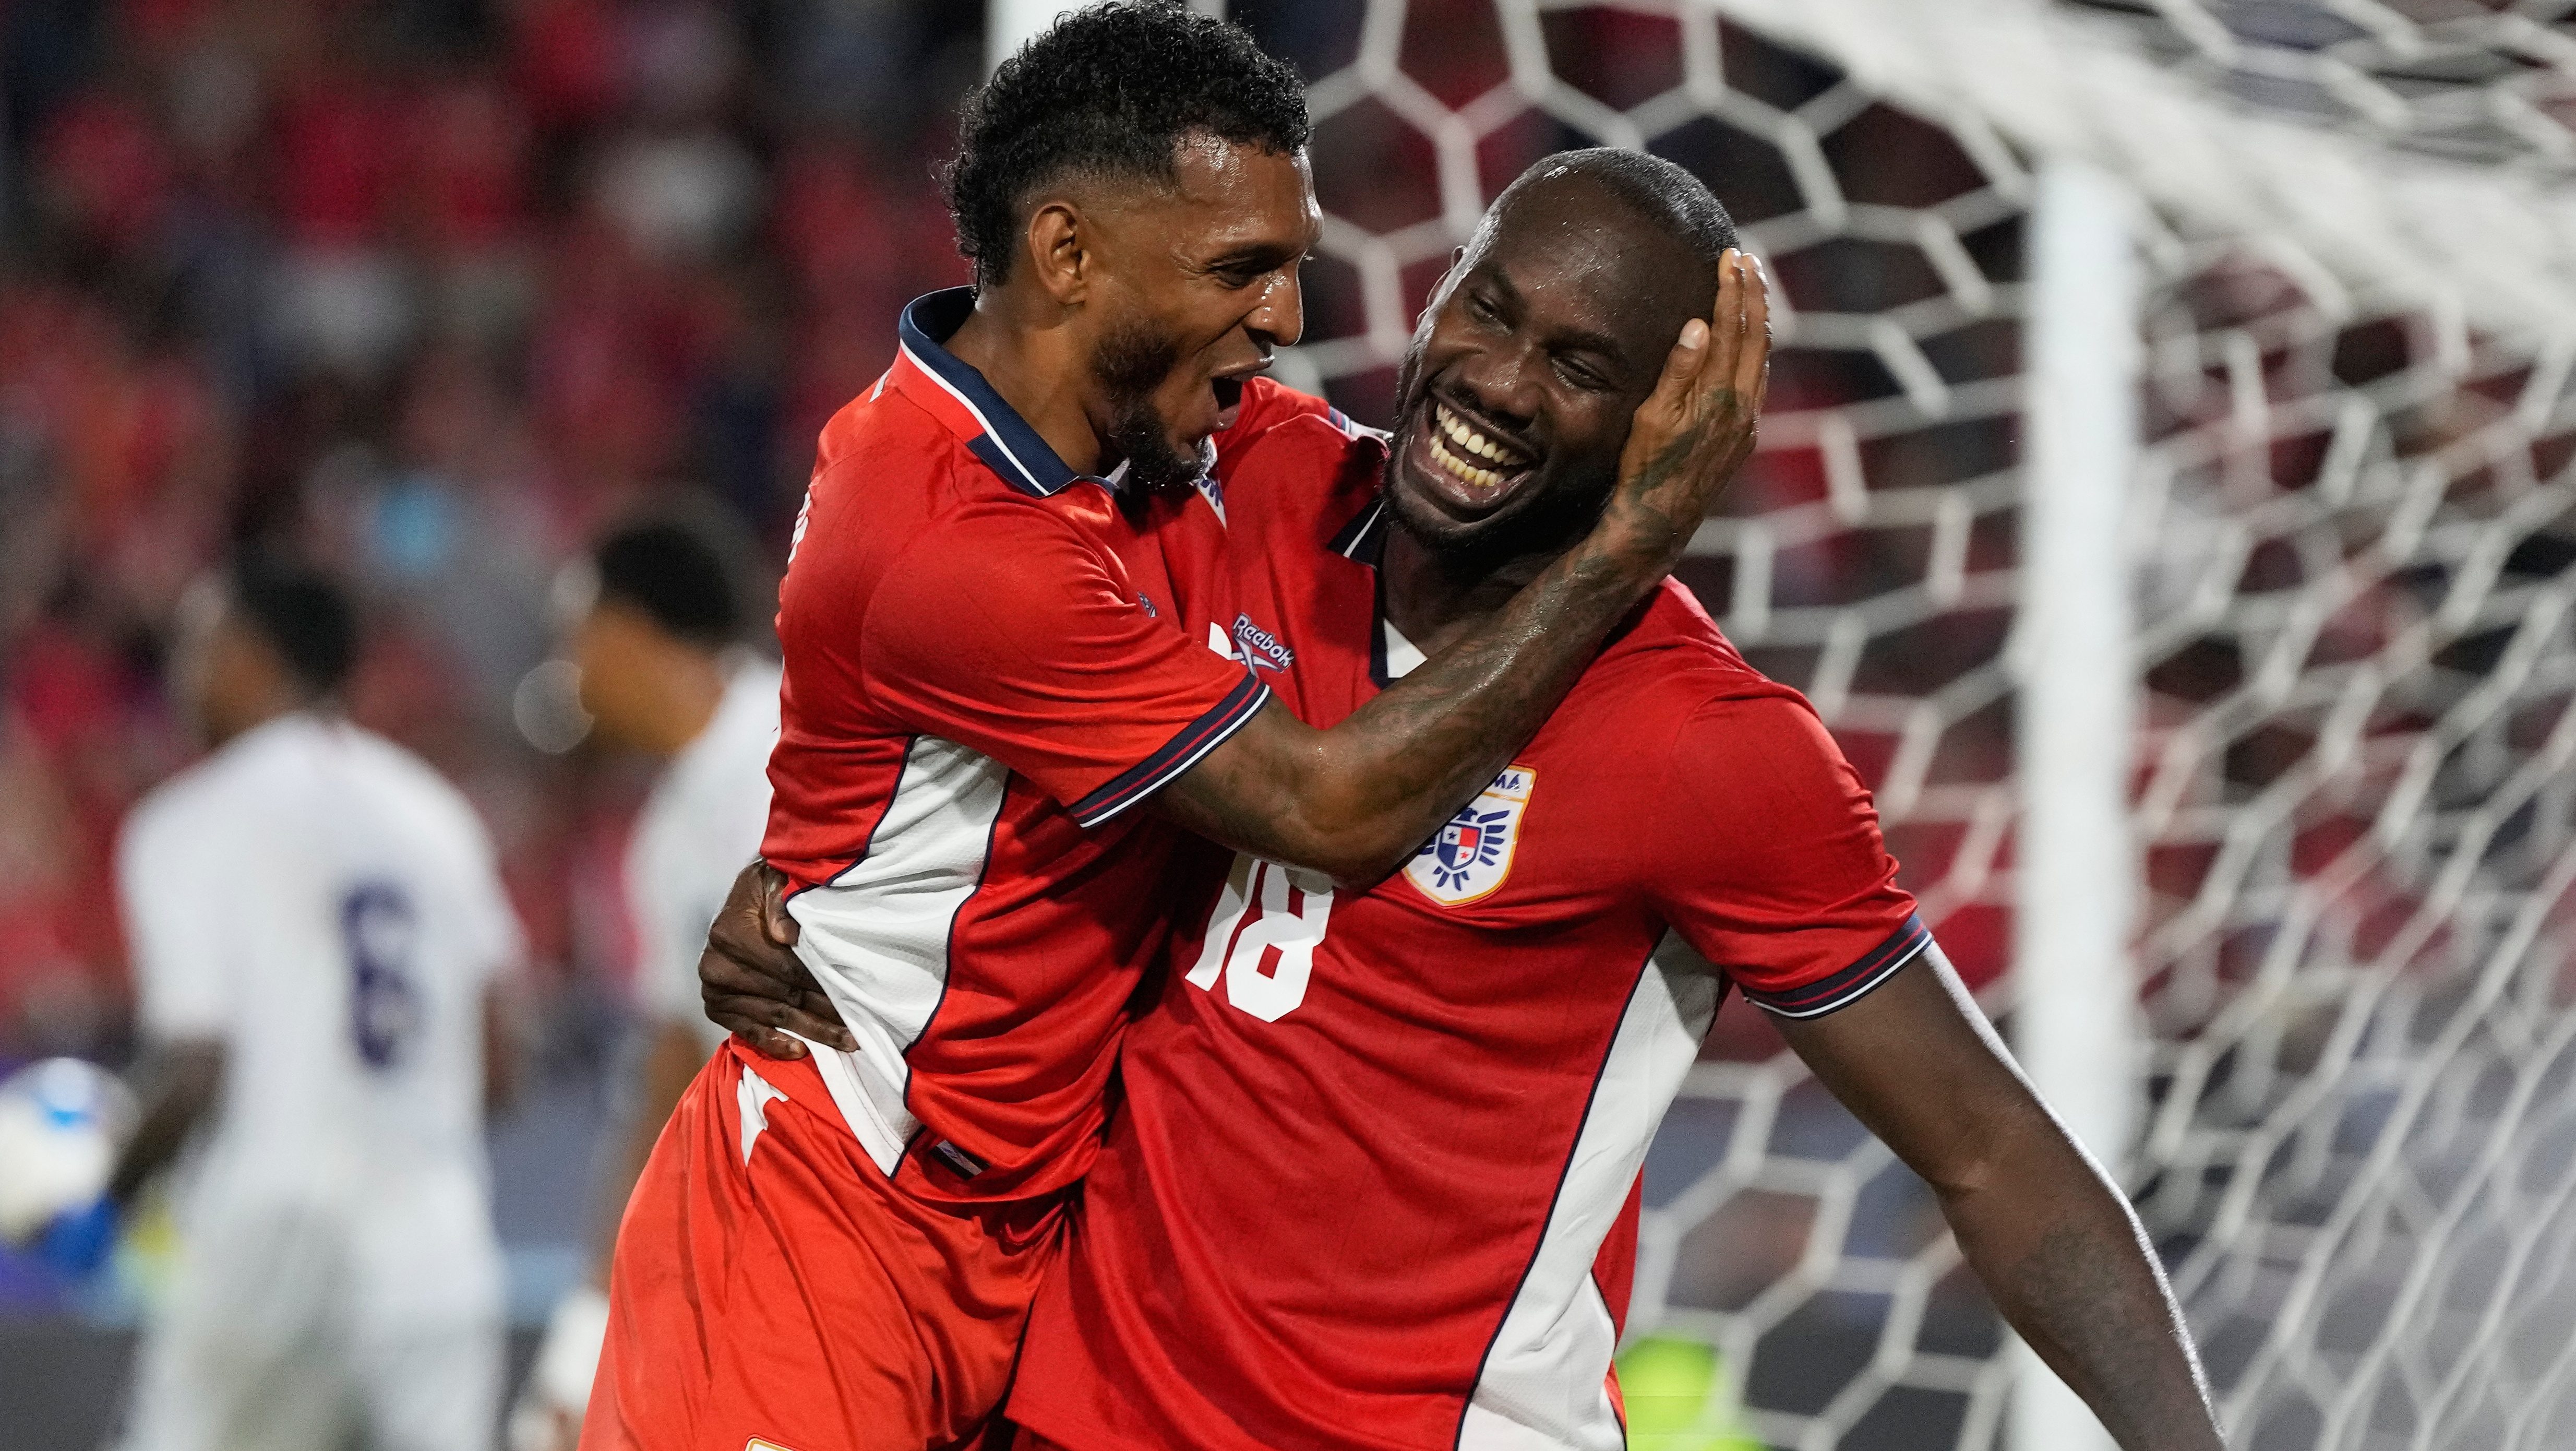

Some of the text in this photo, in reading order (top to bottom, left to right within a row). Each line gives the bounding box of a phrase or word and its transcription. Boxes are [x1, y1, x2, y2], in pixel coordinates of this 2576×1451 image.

[1233, 613, 1295, 668] Reebok
[338, 874, 431, 1074] 6
[1184, 853, 1335, 1023] 18
